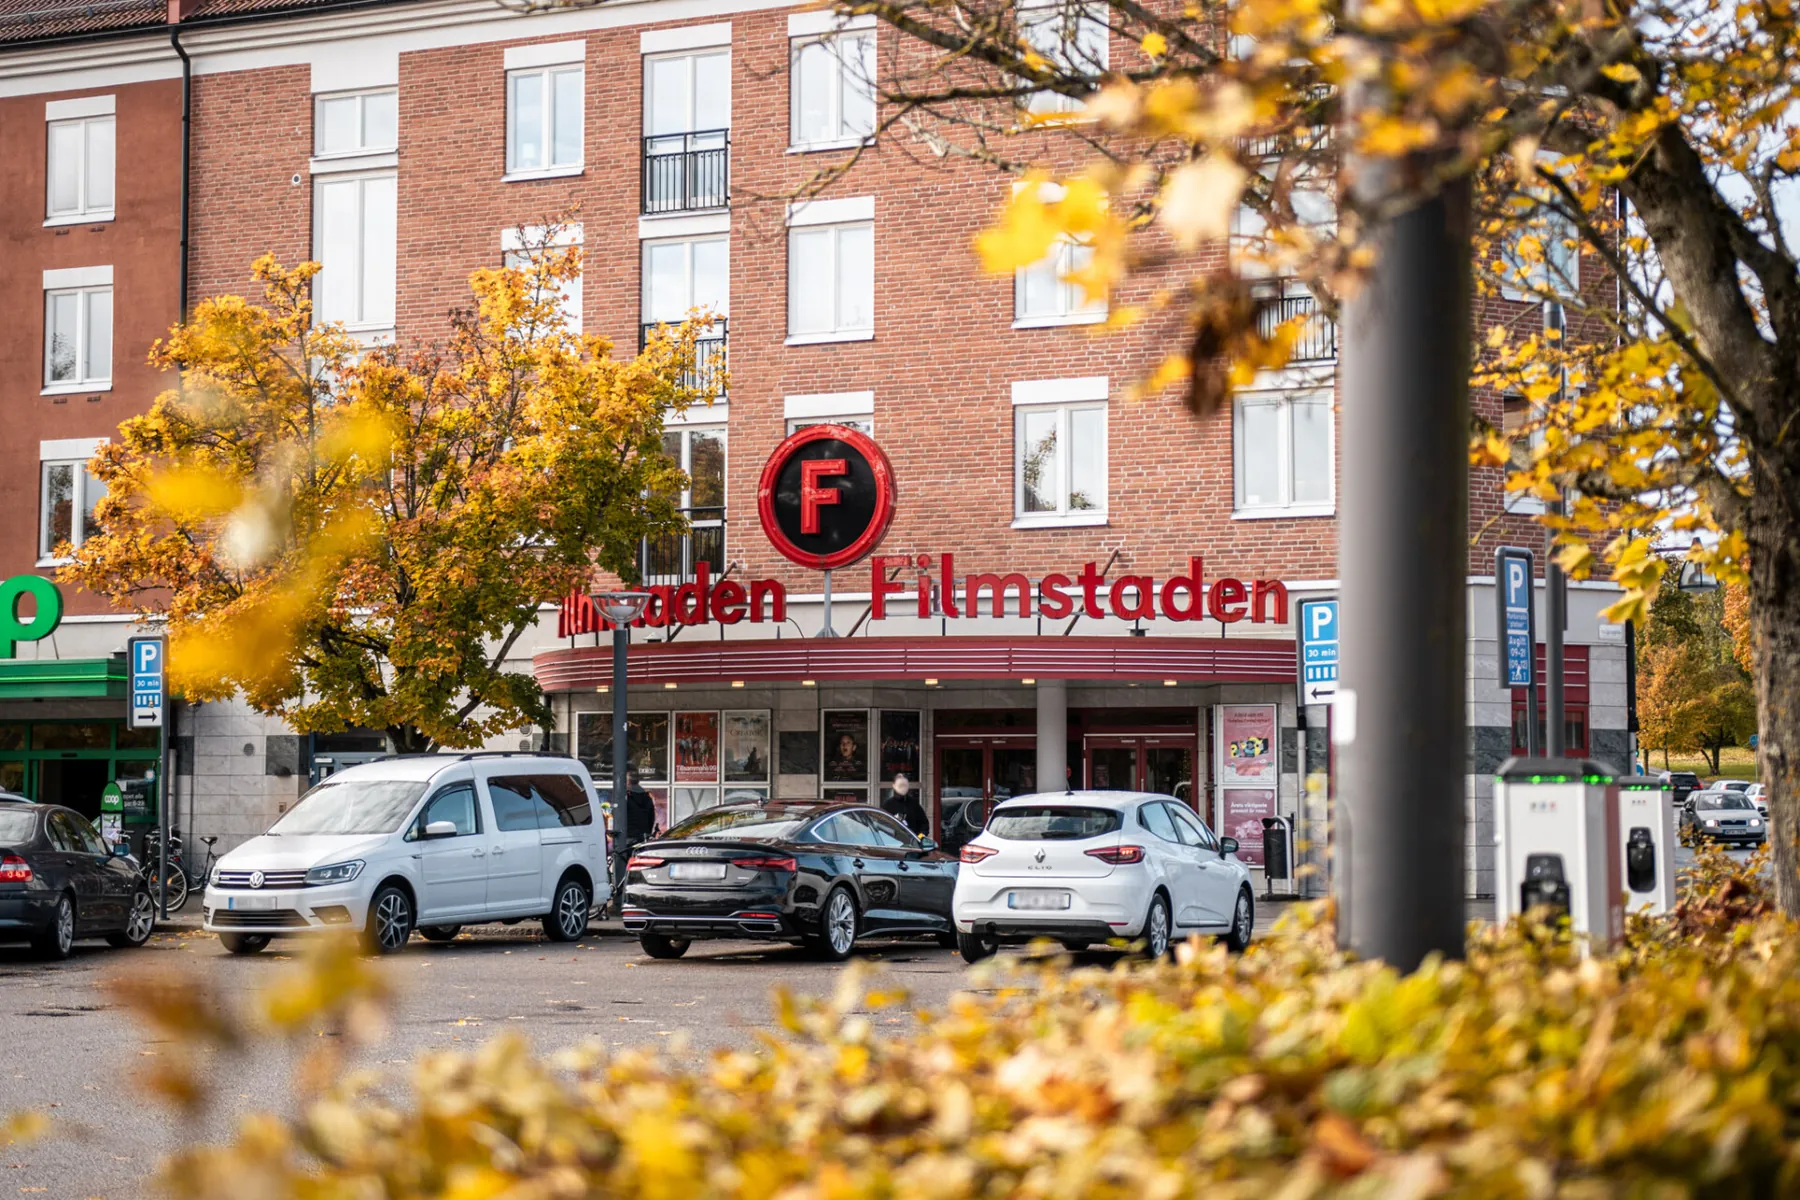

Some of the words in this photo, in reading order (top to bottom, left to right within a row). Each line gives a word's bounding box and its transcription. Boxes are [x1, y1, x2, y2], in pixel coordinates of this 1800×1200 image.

[801, 458, 849, 534] F
[871, 553, 1289, 625] Filmstaden
[1509, 563, 1524, 604] P
[1312, 606, 1332, 639] P
[141, 644, 157, 672] P
[1308, 649, 1318, 657] 30
[1321, 648, 1336, 657] min
[104, 794, 120, 806] coop
